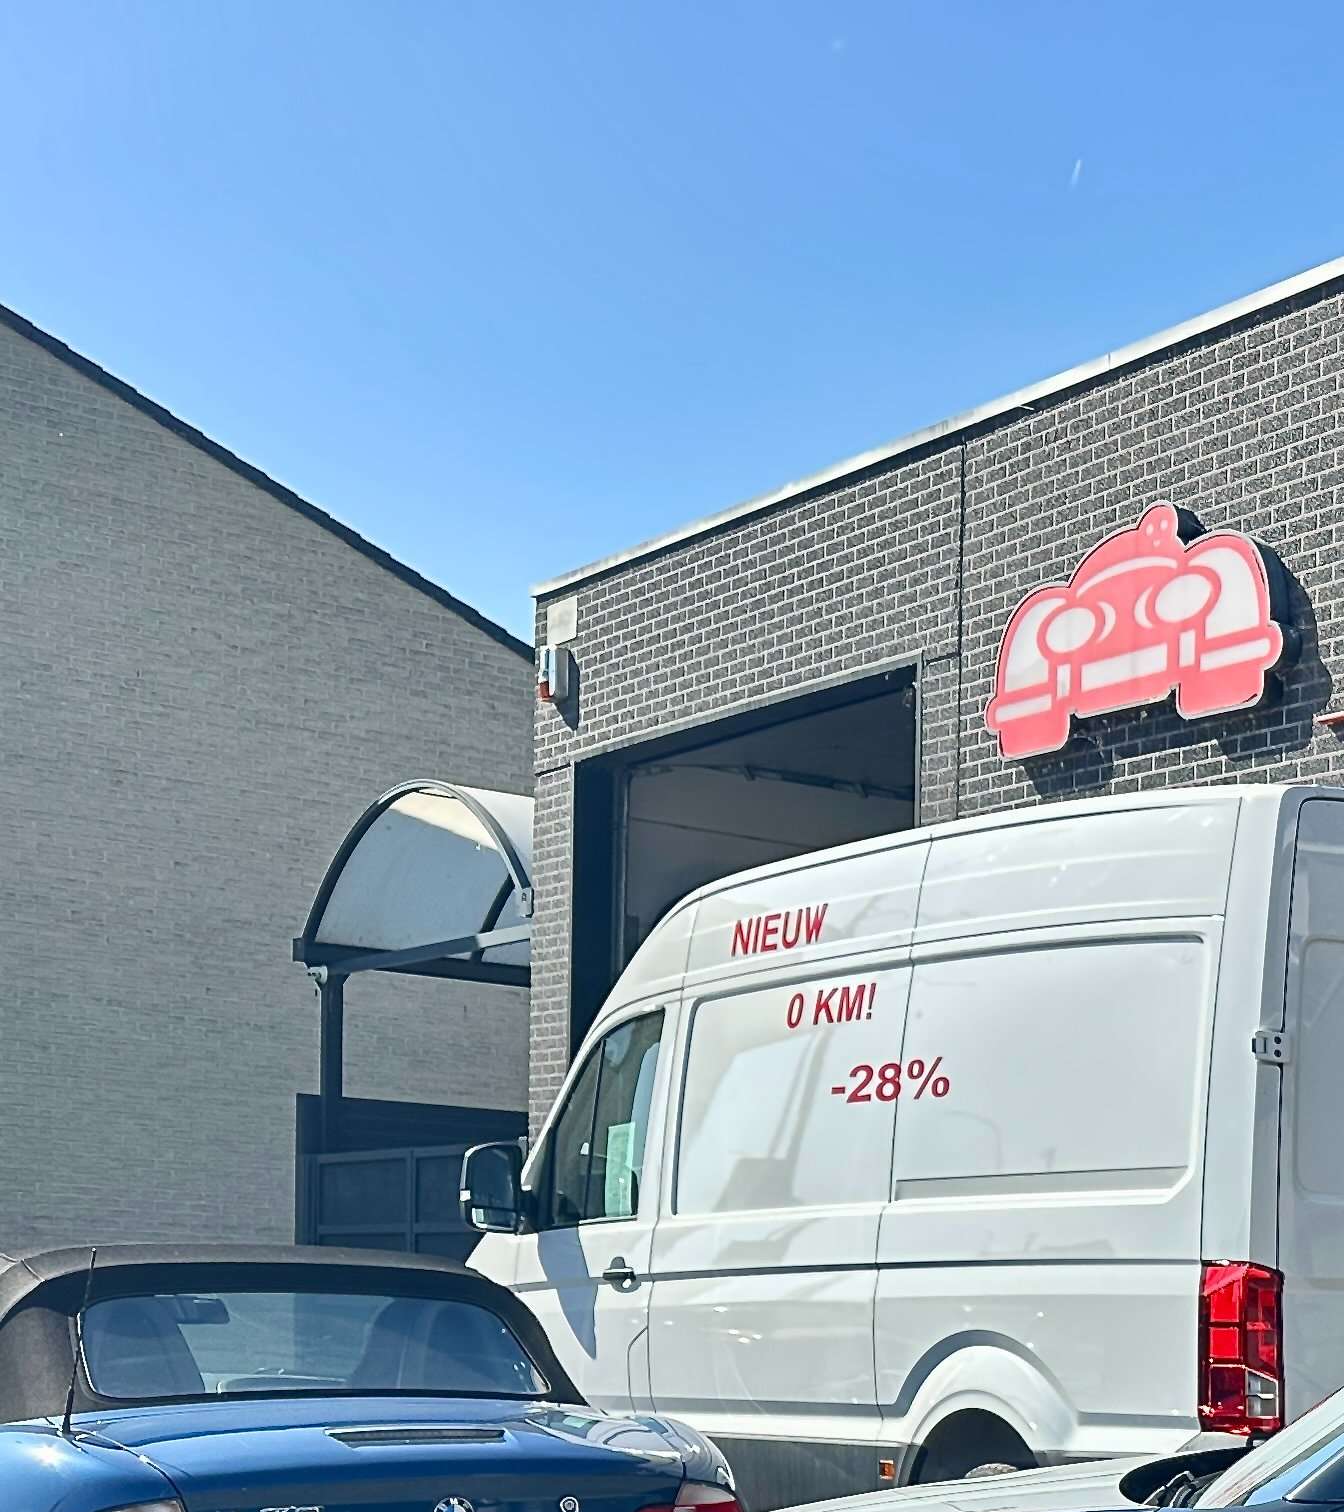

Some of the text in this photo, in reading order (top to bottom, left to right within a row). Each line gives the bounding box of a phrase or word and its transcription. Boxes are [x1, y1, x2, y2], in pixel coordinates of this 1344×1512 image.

[731, 903, 829, 957] NIEUW
[786, 982, 877, 1029] 0 KM!
[831, 1056, 950, 1103] -28%
